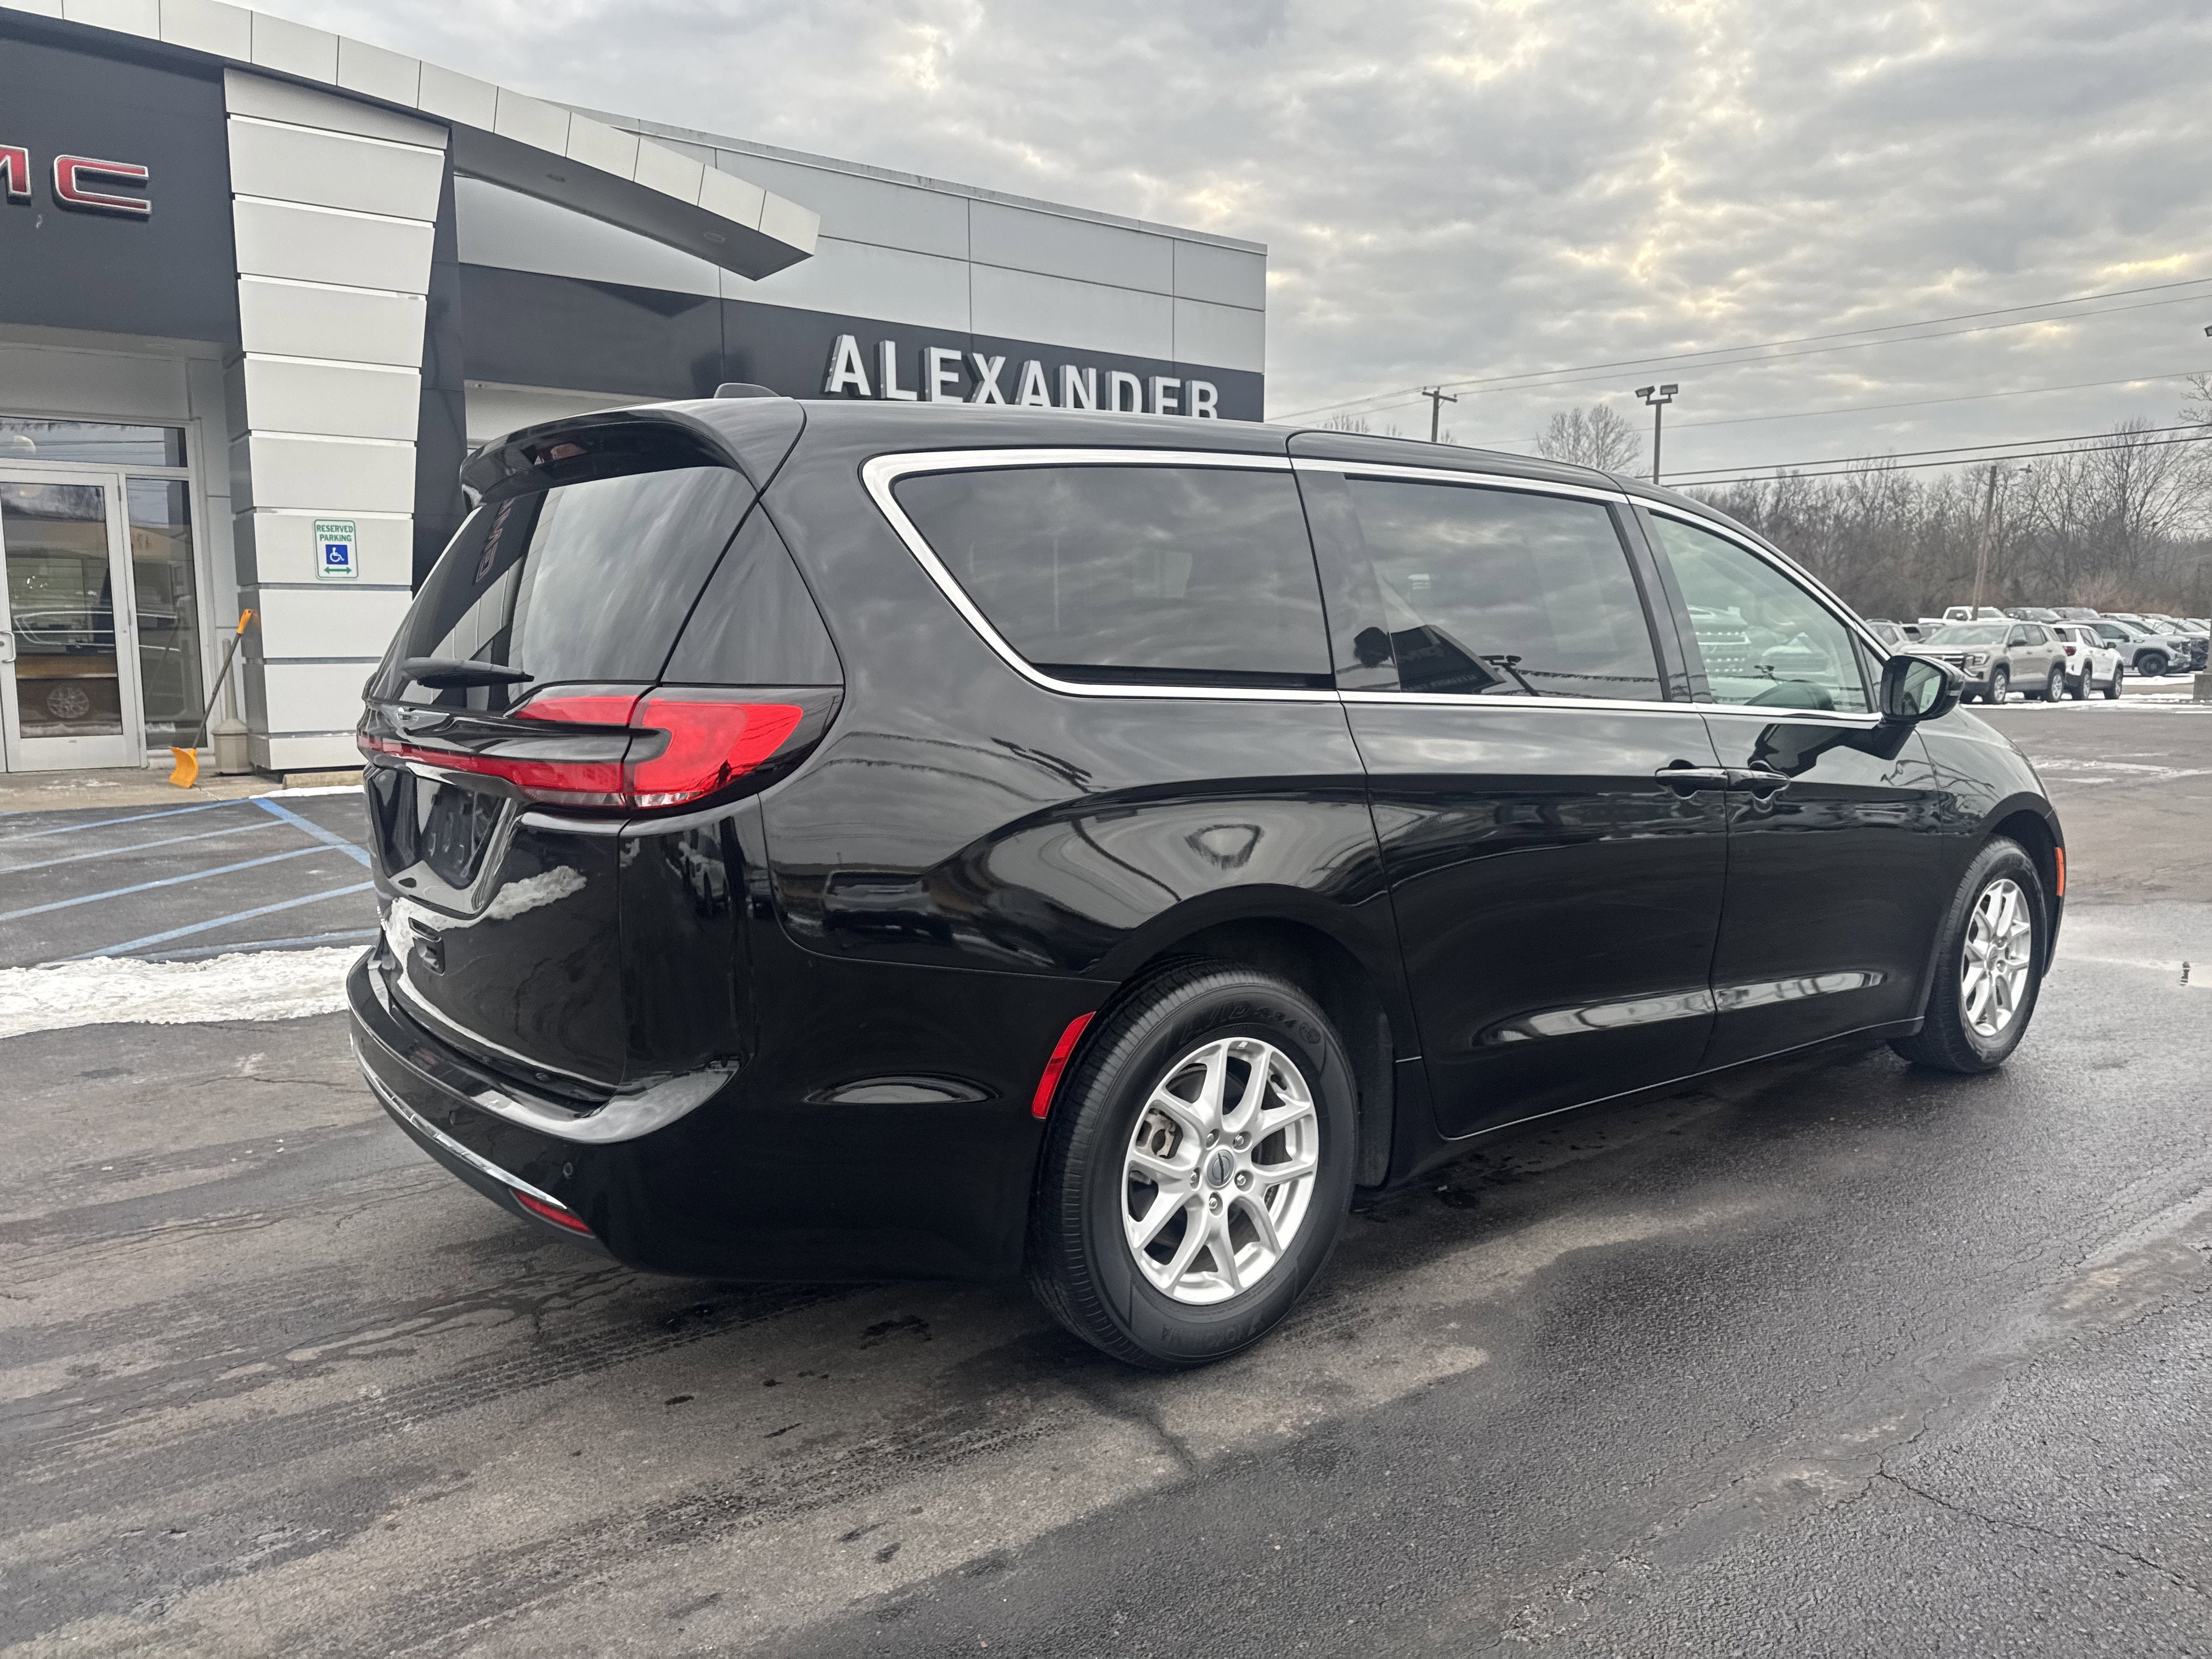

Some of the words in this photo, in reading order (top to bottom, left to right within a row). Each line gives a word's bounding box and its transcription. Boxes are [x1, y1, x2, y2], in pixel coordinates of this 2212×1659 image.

[825, 334, 1219, 419] ALEXANDER
[316, 524, 354, 533] RESERVED
[319, 534, 352, 542] PARKING
